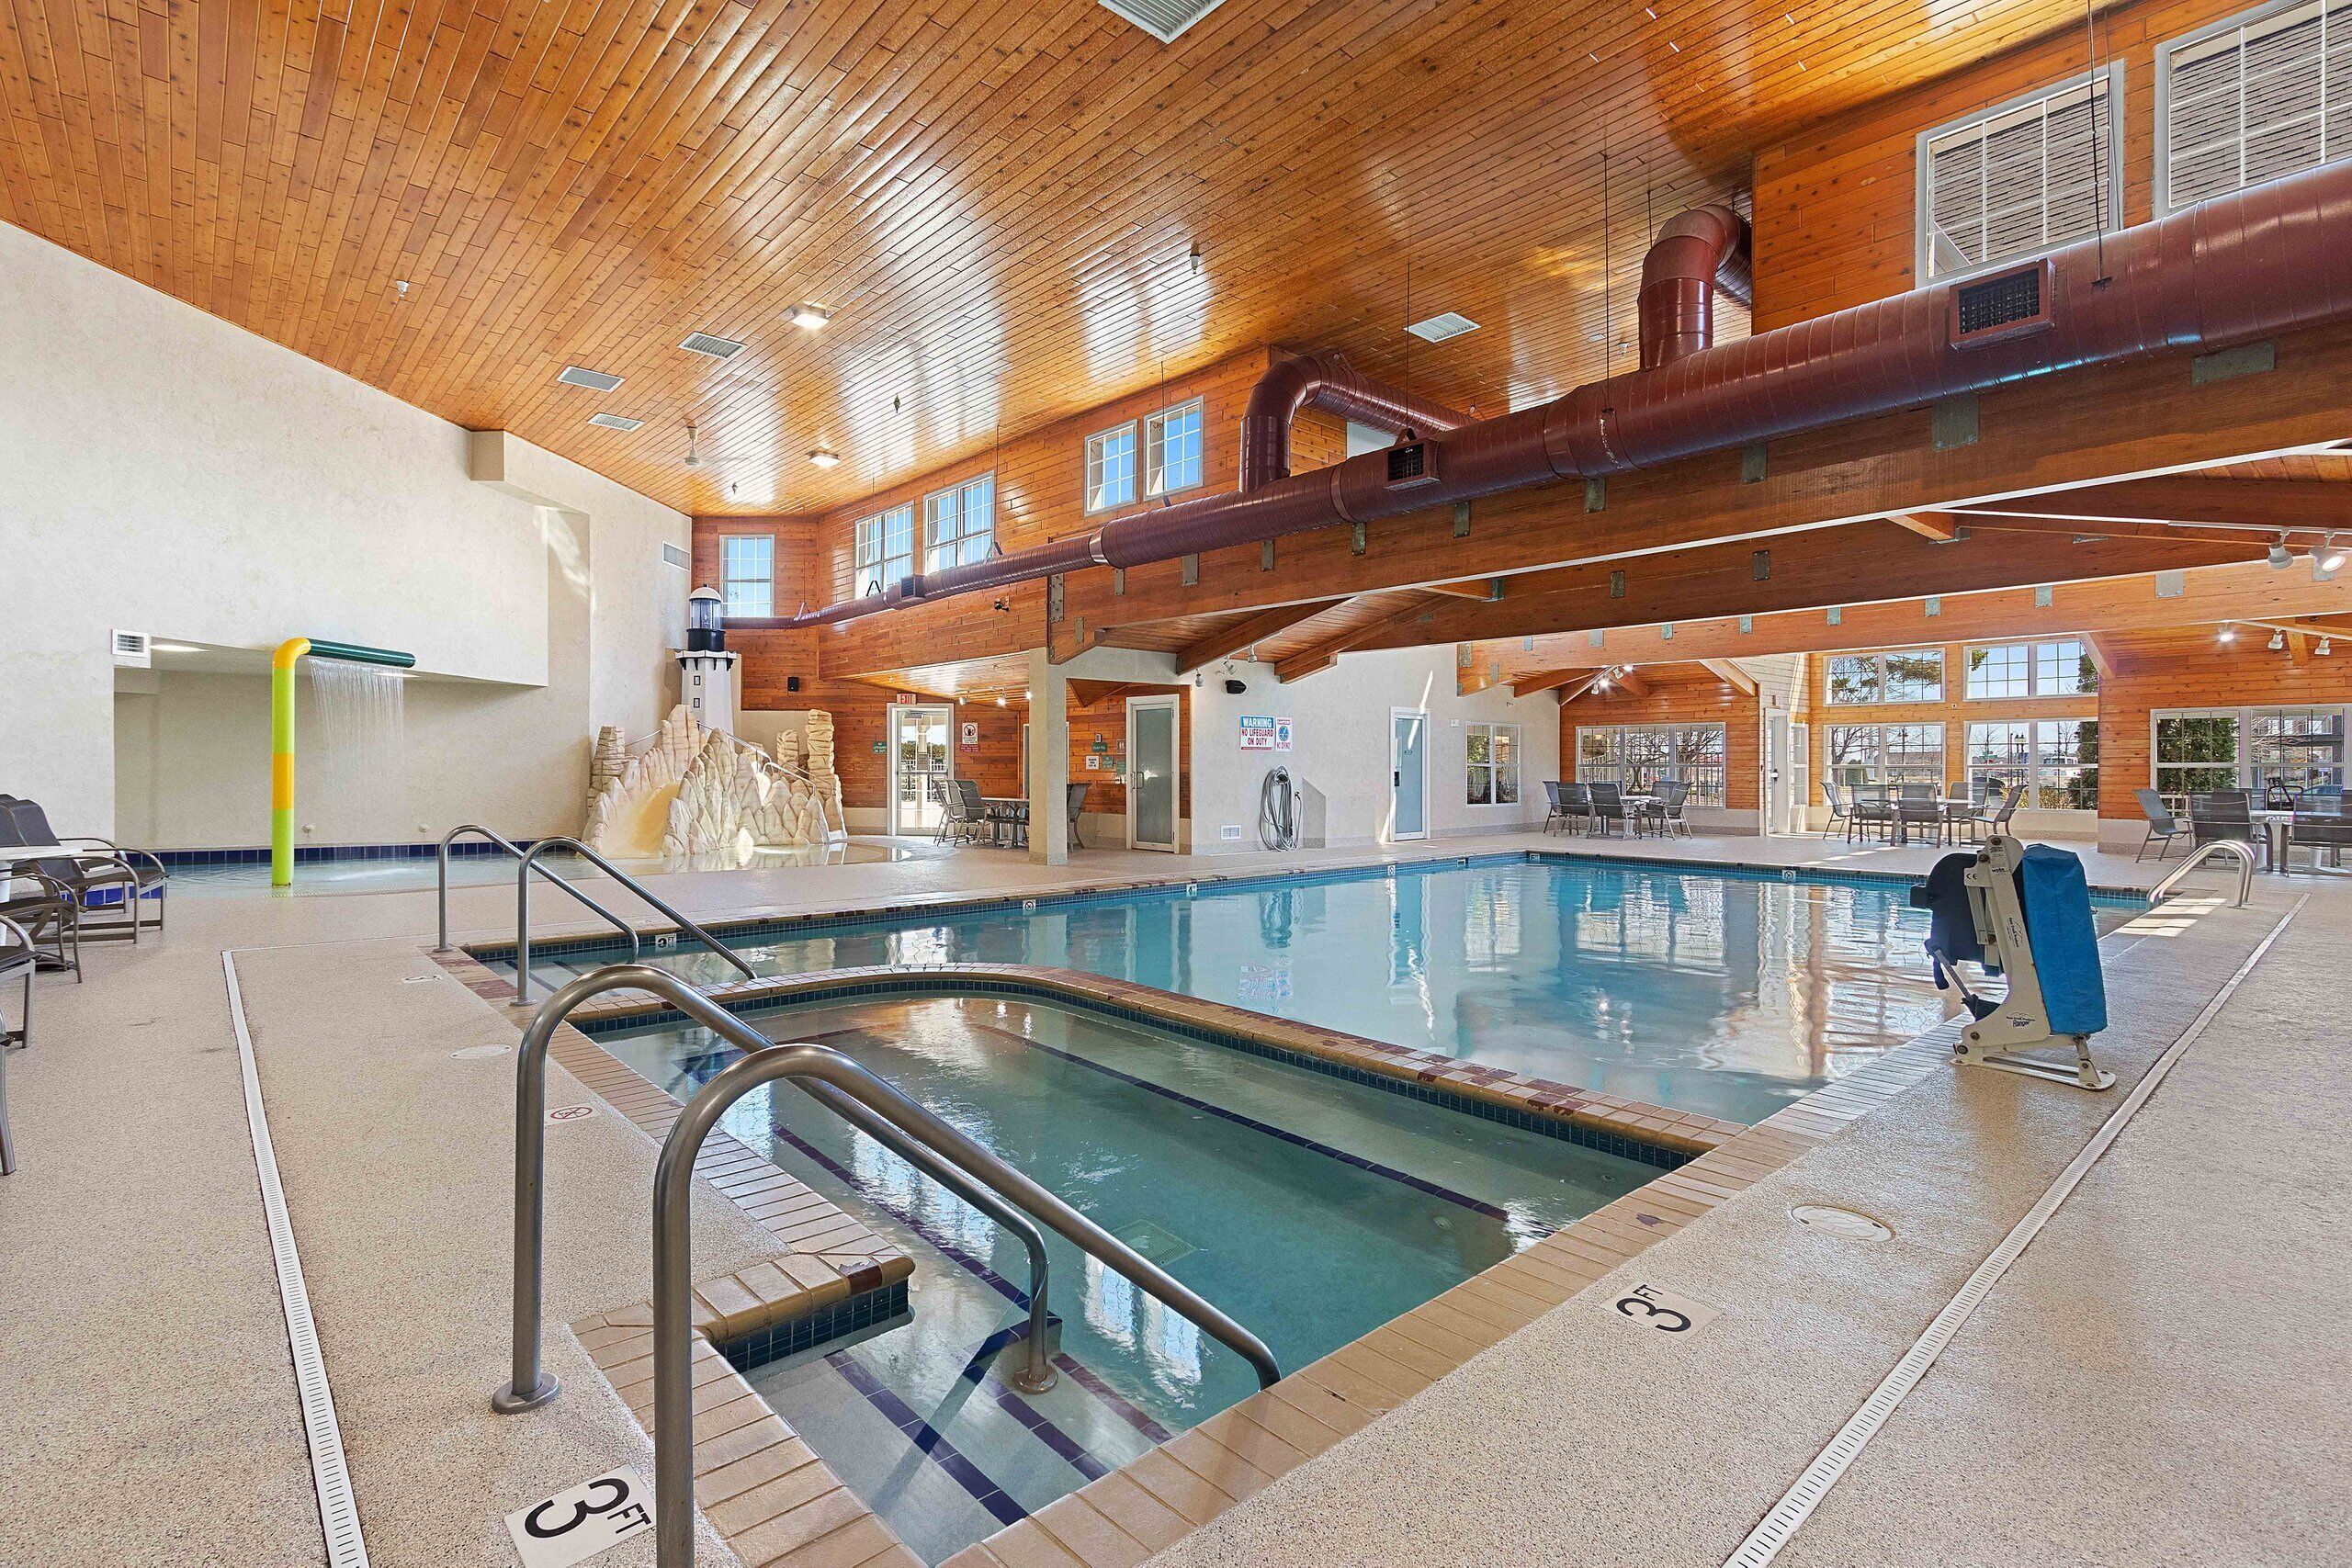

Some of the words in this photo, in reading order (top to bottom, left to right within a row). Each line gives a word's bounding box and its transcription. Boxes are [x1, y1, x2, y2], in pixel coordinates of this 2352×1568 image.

[1242, 716, 1272, 728] WARNING
[1241, 728, 1248, 737] NO
[1250, 728, 1273, 737] LIFEGUARD
[1632, 1283, 1664, 1302] FT
[1616, 1297, 1691, 1332] 3
[524, 1477, 630, 1539] 3
[606, 1502, 652, 1535] FT
